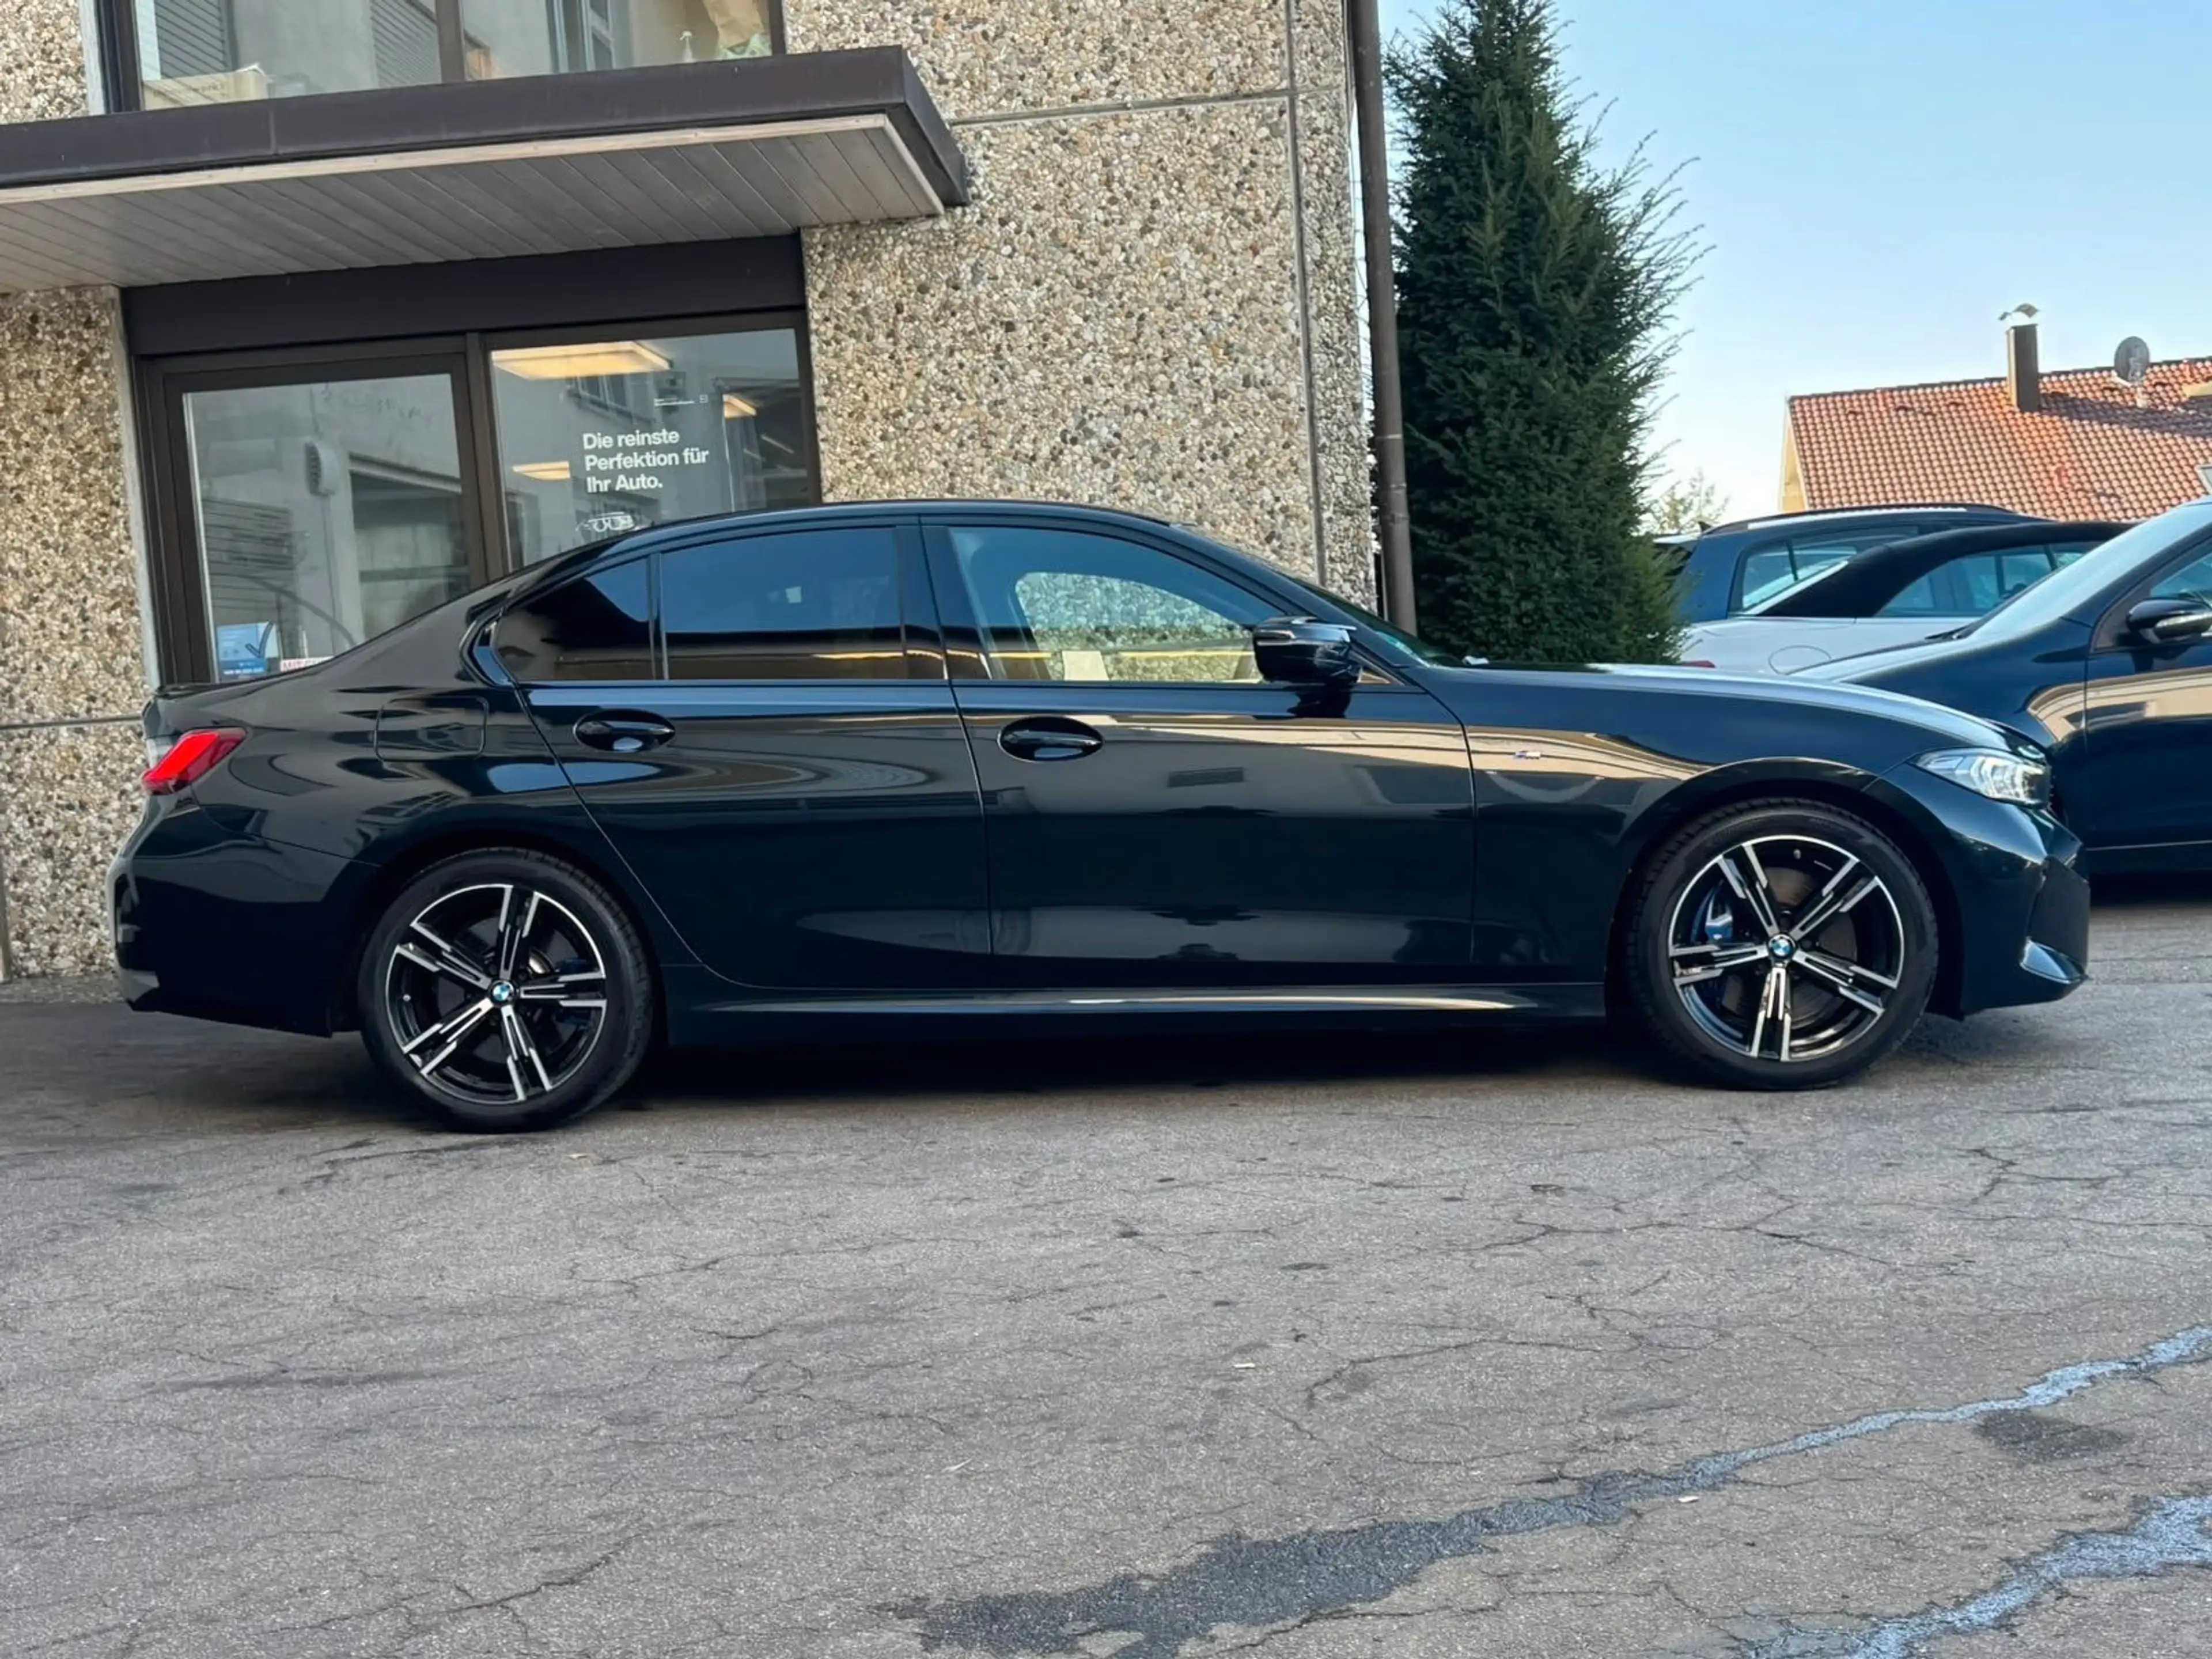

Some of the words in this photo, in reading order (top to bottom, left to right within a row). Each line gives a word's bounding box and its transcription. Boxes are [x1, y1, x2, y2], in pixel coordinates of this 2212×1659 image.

[583, 433, 613, 449] Die
[617, 429, 680, 447] reinste
[584, 450, 679, 471] Perfektion
[683, 448, 709, 464] für
[586, 475, 611, 493] Ihr
[615, 474, 663, 491] Auto.
